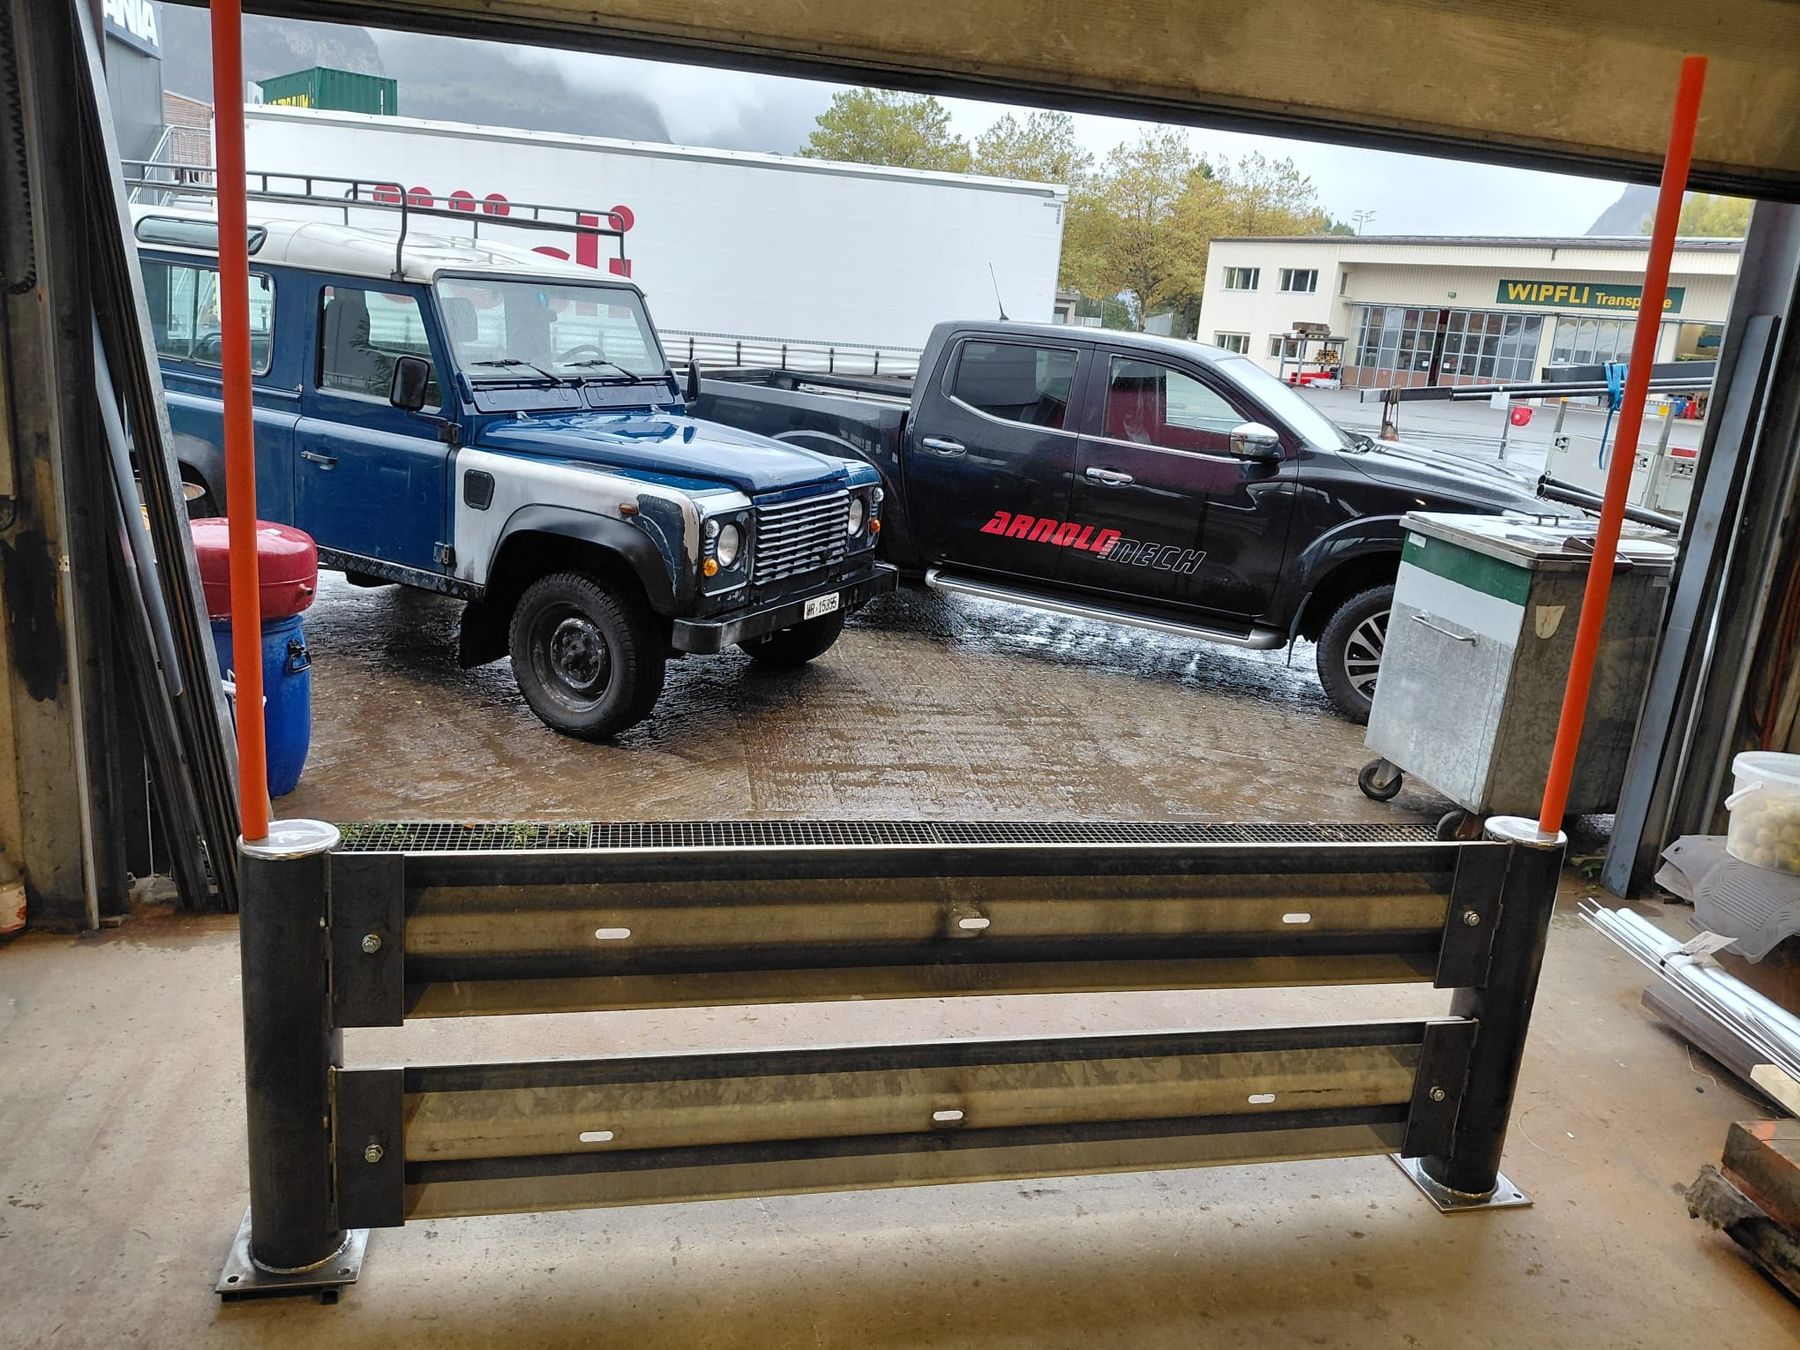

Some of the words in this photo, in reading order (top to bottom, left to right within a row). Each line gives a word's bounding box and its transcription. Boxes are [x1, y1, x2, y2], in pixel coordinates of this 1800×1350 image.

[1507, 282, 1590, 304] WIPFLI
[1596, 292, 1672, 310] Transpe
[980, 510, 1122, 557] ARNOLD
[1108, 537, 1207, 575] MECH
